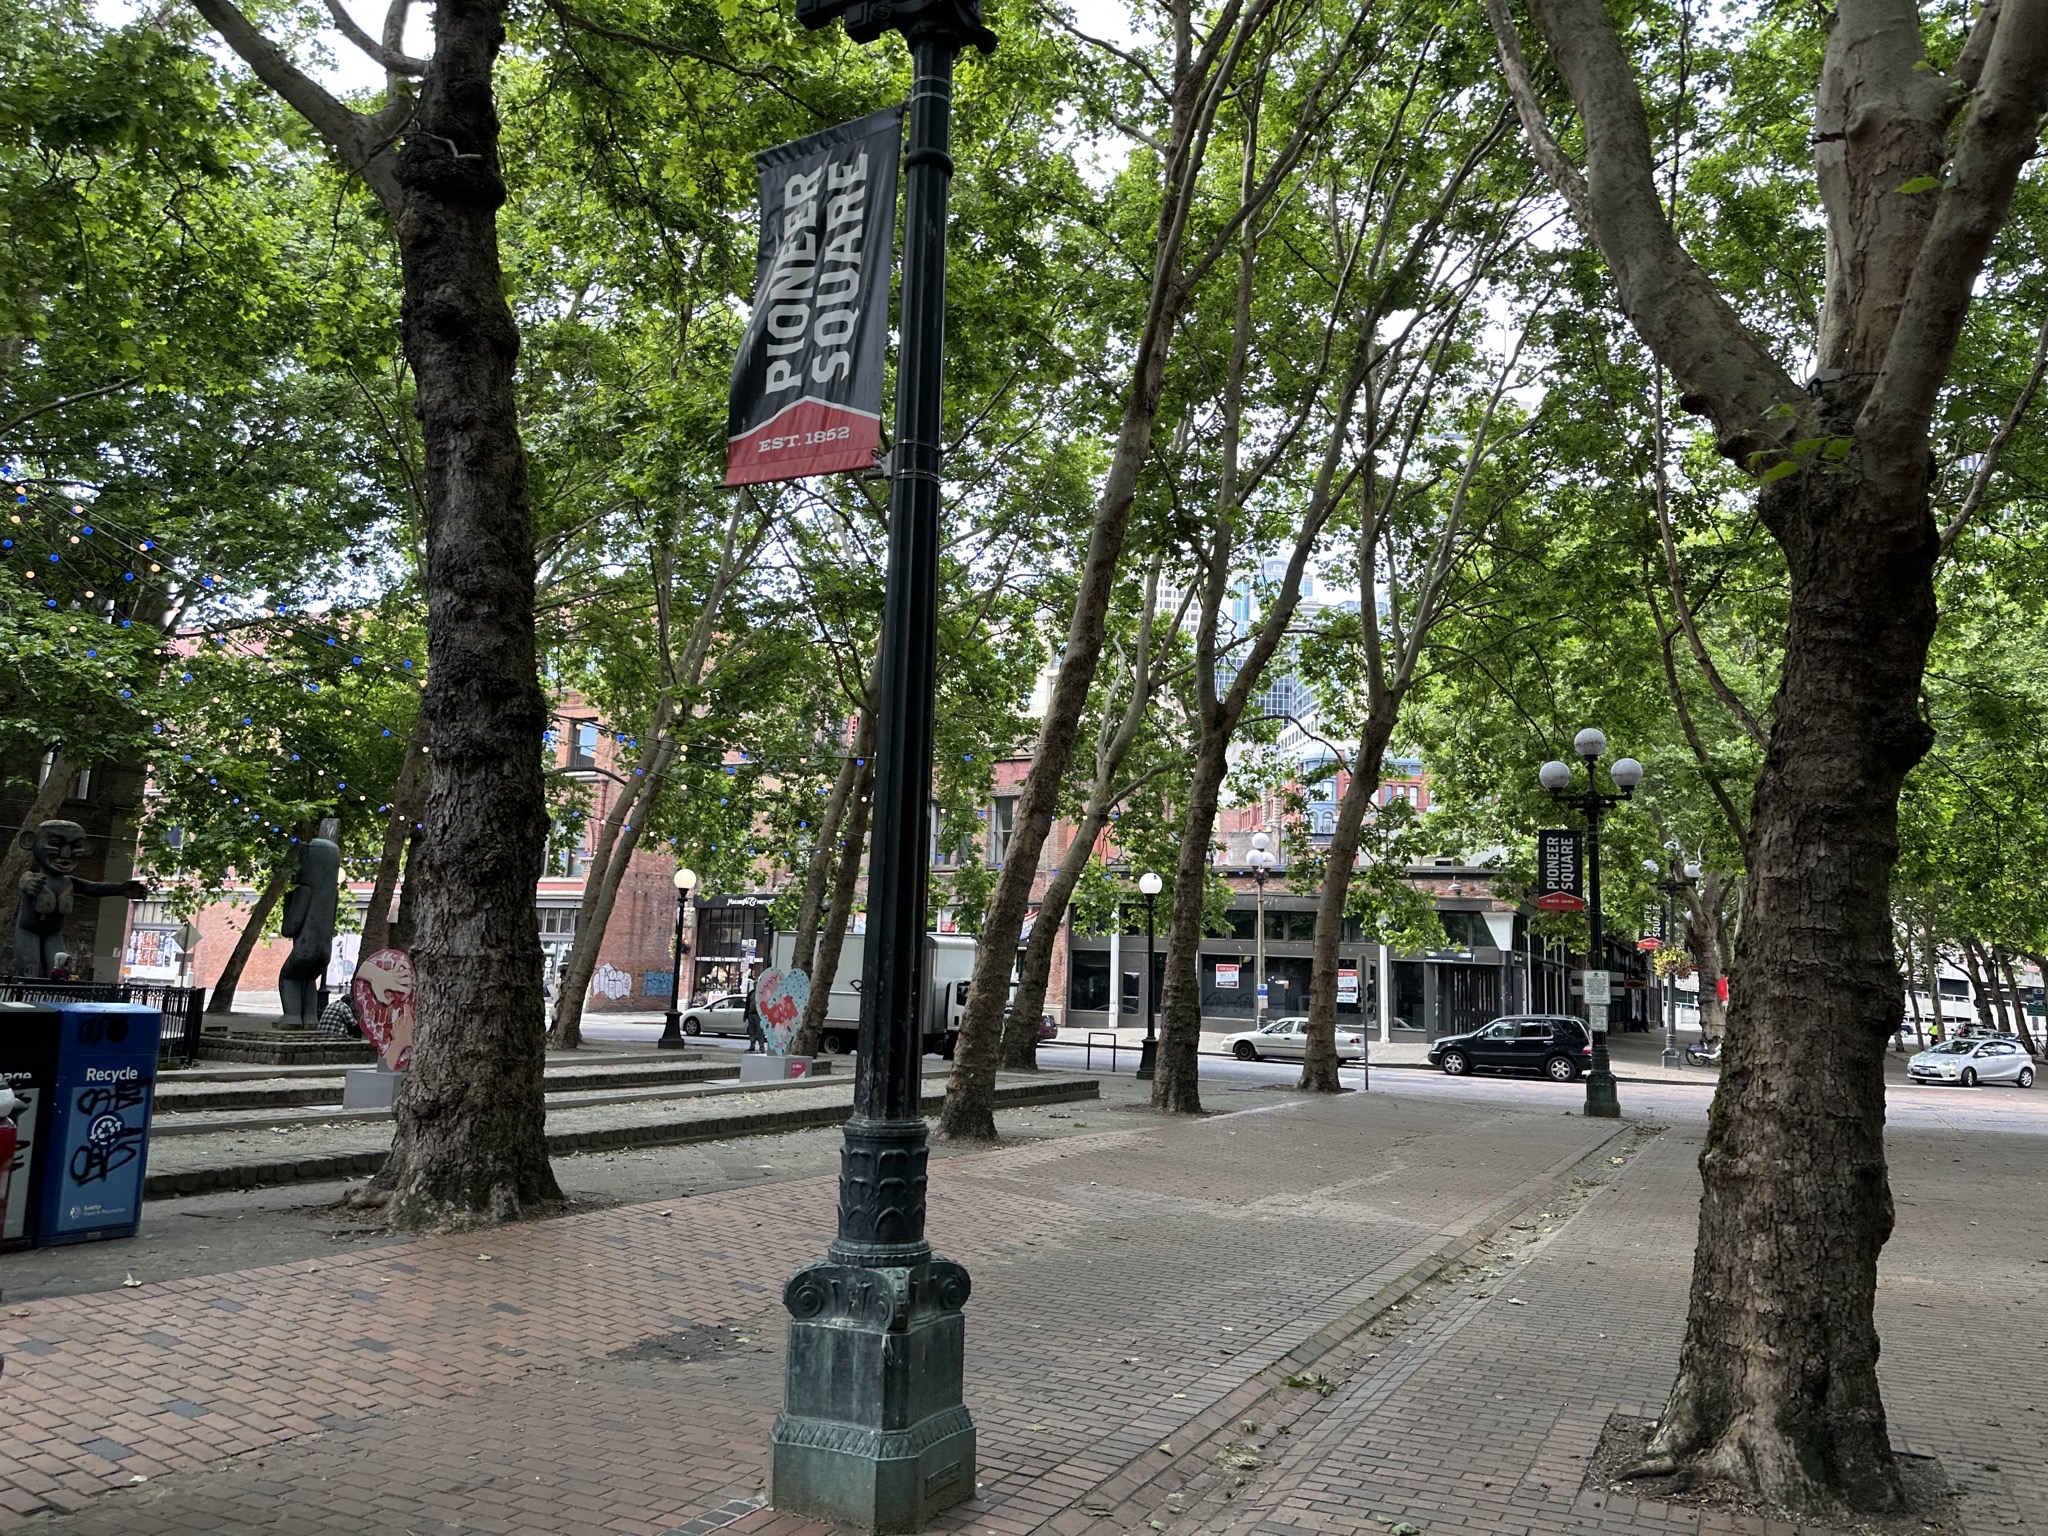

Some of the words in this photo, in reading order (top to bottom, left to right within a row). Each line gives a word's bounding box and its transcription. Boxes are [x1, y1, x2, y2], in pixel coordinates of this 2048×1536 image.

[766, 164, 823, 395] PIONEER
[811, 153, 869, 386] SQUARE
[758, 434, 800, 453] EST.
[805, 426, 850, 445] 1852
[1546, 836, 1559, 890] PIONEER
[1560, 837, 1575, 890] SQUARE
[86, 1066, 138, 1083] Recycle
